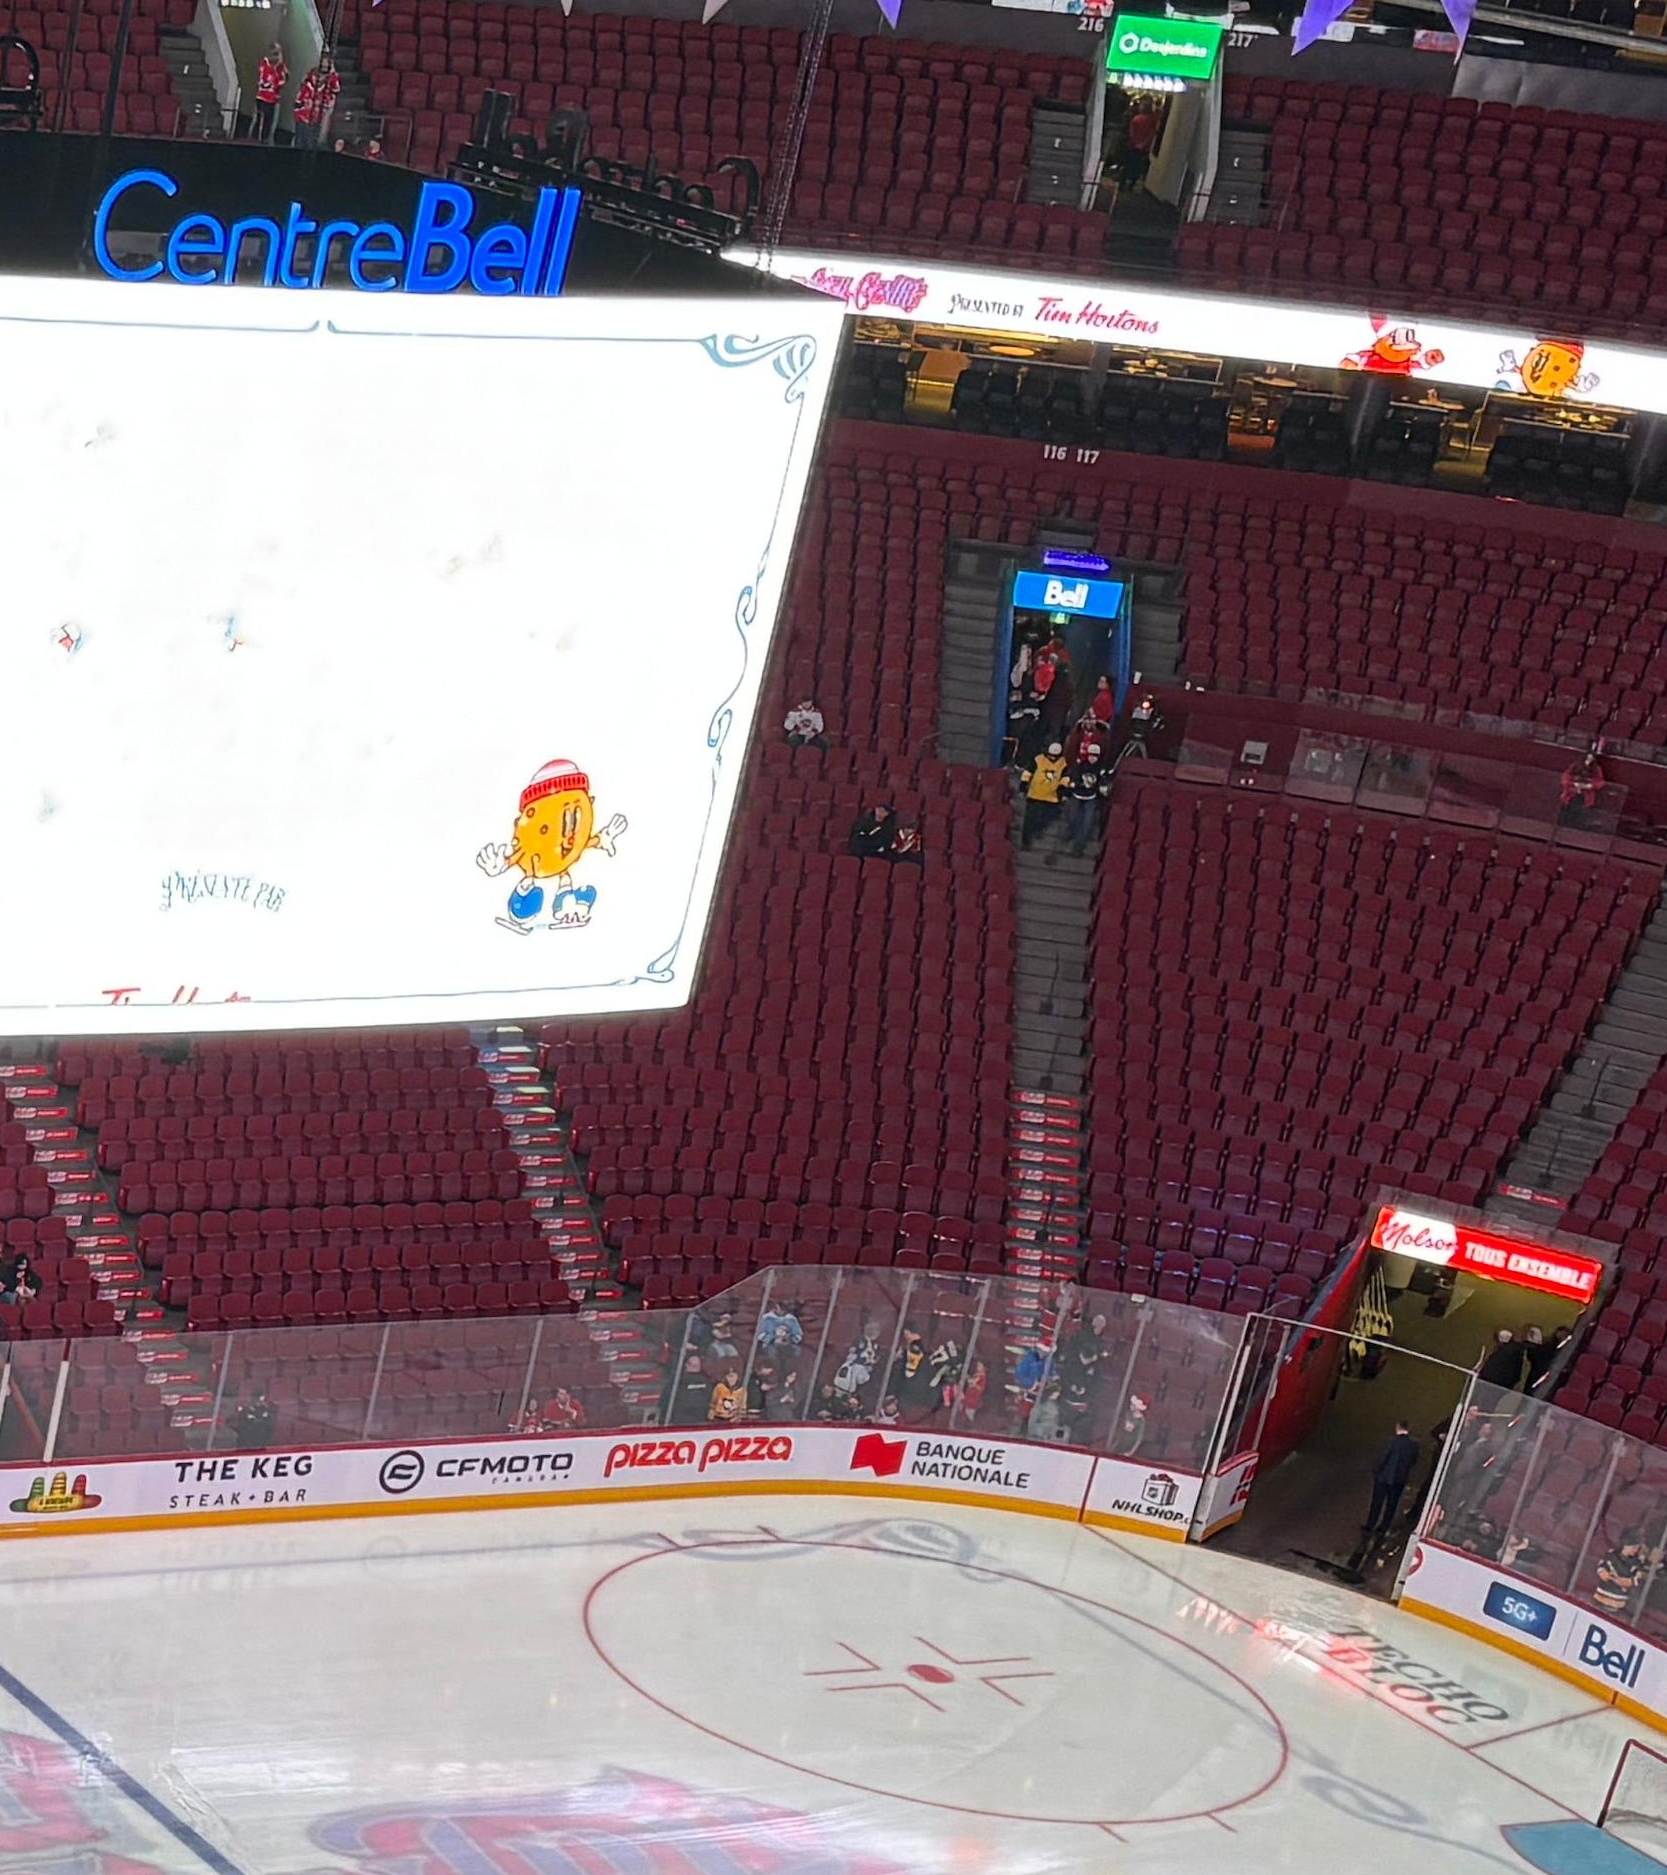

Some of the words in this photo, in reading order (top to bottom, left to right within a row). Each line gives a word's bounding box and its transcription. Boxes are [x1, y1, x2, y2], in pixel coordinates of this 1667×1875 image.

[1077, 17, 1105, 33] 216
[1140, 37, 1208, 58] Desjardins
[1227, 33, 1252, 47] 217
[94, 168, 582, 296] CentreBell
[1035, 297, 1072, 325] Tim
[1075, 300, 1160, 334] Hortons
[1044, 445, 1067, 460] 116
[1076, 448, 1100, 464] 117
[1043, 580, 1089, 609] Bell
[1464, 1241, 1508, 1269] TOUS
[1506, 1254, 1593, 1292] ENSEMBLE
[436, 1453, 574, 1478] CFMOTO
[603, 1440, 695, 1478] pizza
[698, 1435, 793, 1473] pizza
[917, 1441, 1006, 1466] BANQUE
[175, 1459, 242, 1484] THE
[252, 1455, 314, 1480] KEG
[910, 1461, 1030, 1490] NATIONALE
[169, 1491, 242, 1509] STEAK
[264, 1487, 308, 1505] BAR
[1501, 1596, 1538, 1622] 5G+
[1578, 1623, 1645, 1689] Bell
